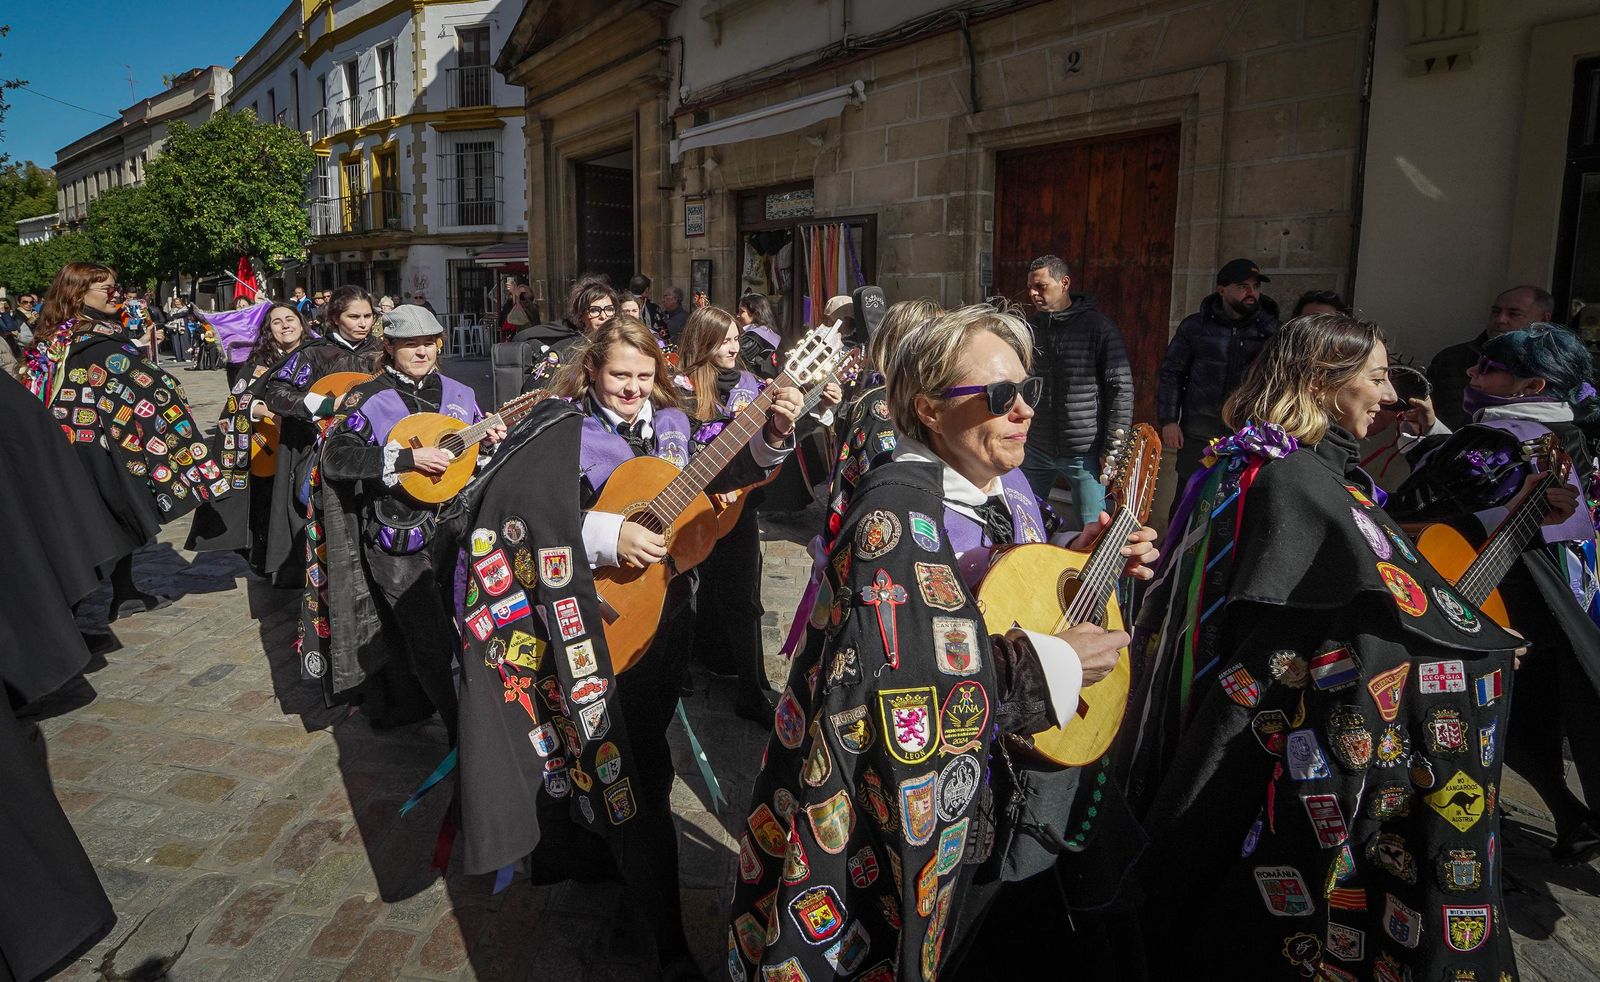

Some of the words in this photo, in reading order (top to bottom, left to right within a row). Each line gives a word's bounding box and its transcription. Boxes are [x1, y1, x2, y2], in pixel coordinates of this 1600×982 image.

[1066, 51, 1081, 73] 2
[935, 622, 973, 630] CANTABRA
[1422, 674, 1461, 682] GEORGIA
[572, 679, 607, 702] OOPS!
[904, 750, 927, 760] LEON
[1446, 784, 1478, 792] KANGAROOS
